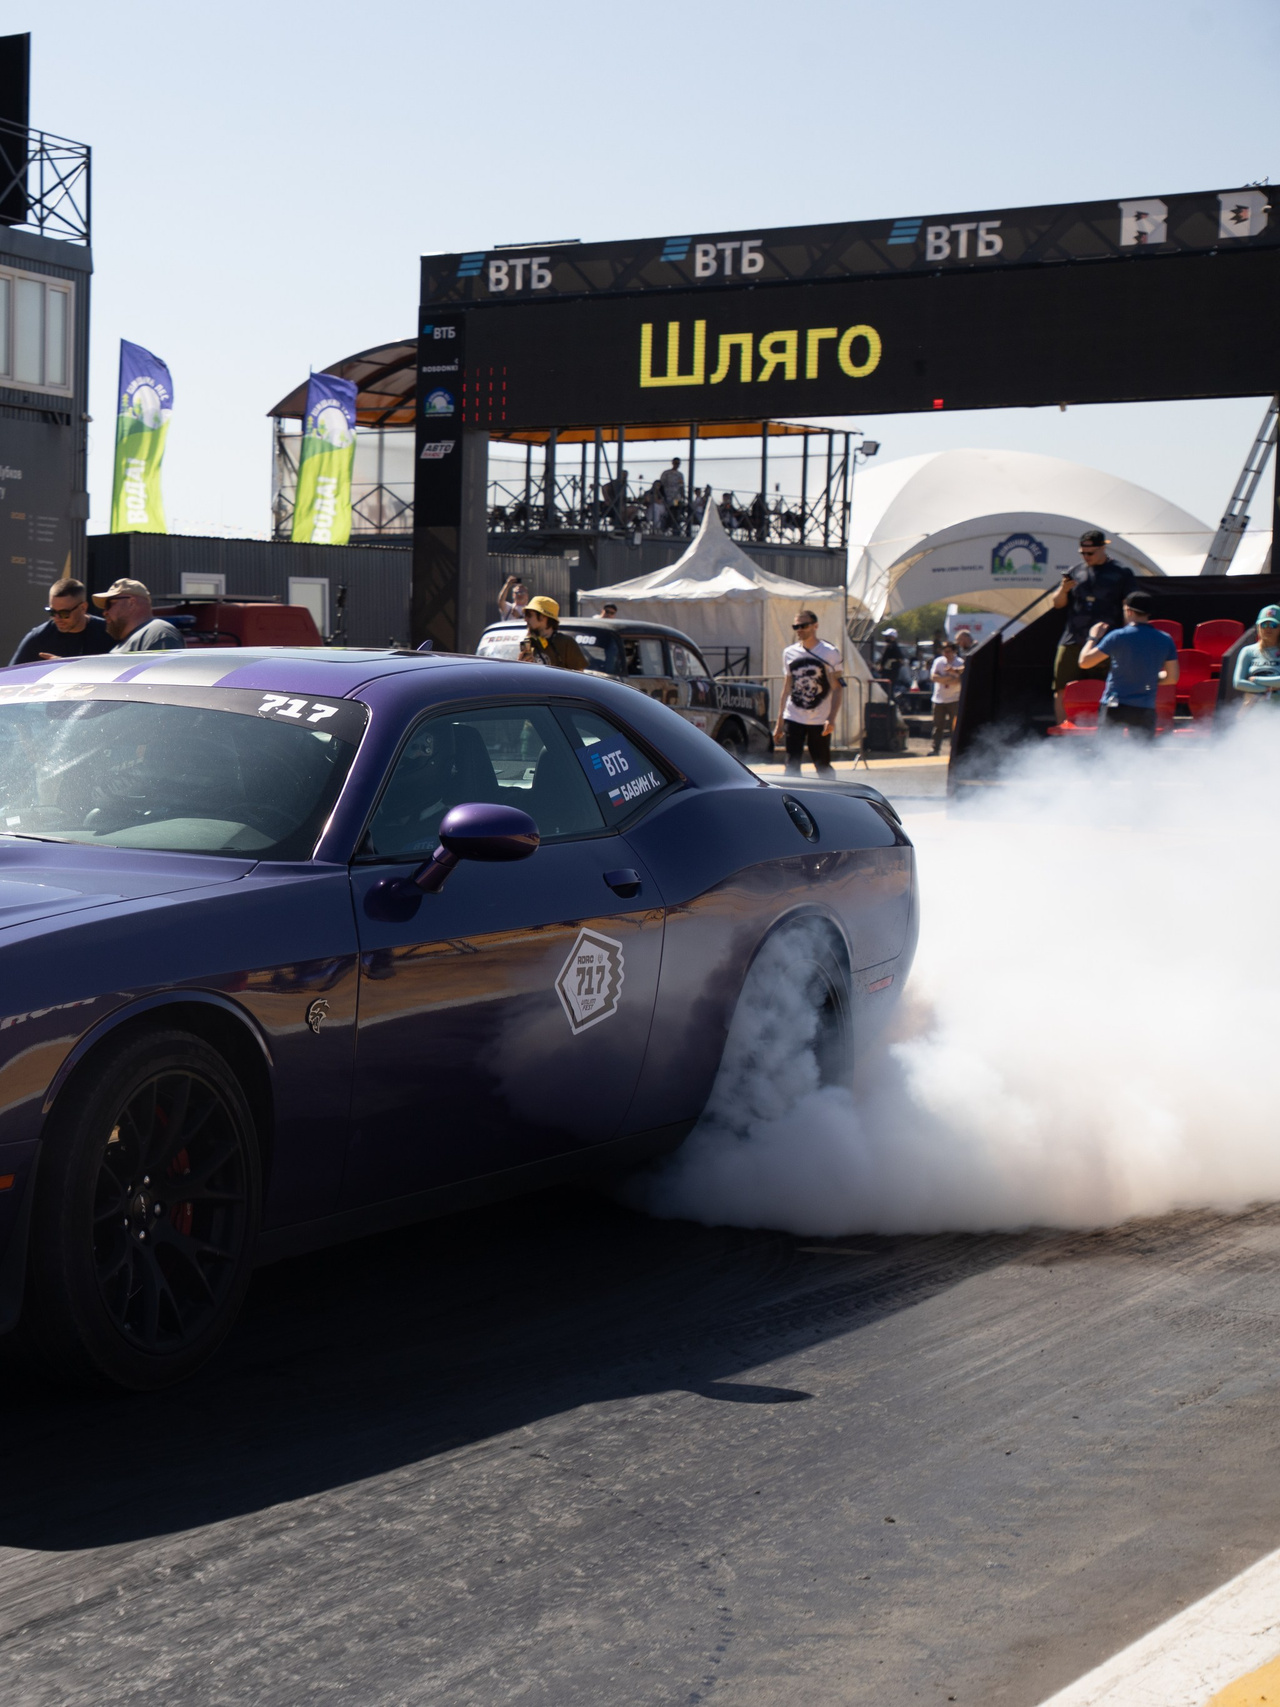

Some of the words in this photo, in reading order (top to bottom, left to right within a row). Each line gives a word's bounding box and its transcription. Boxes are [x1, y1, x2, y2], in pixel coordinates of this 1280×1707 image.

[694, 239, 765, 278] ВТБ
[925, 220, 1004, 263] ВТБ
[488, 256, 553, 293] ВТБ
[433, 326, 456, 340] ВТБ
[123, 457, 149, 524] ВОДА!
[311, 476, 338, 544] ВОДА!
[258, 693, 339, 723] 717
[601, 749, 629, 777] ВТБ
[620, 776, 652, 802] БАБИН
[576, 965, 606, 996] 717
